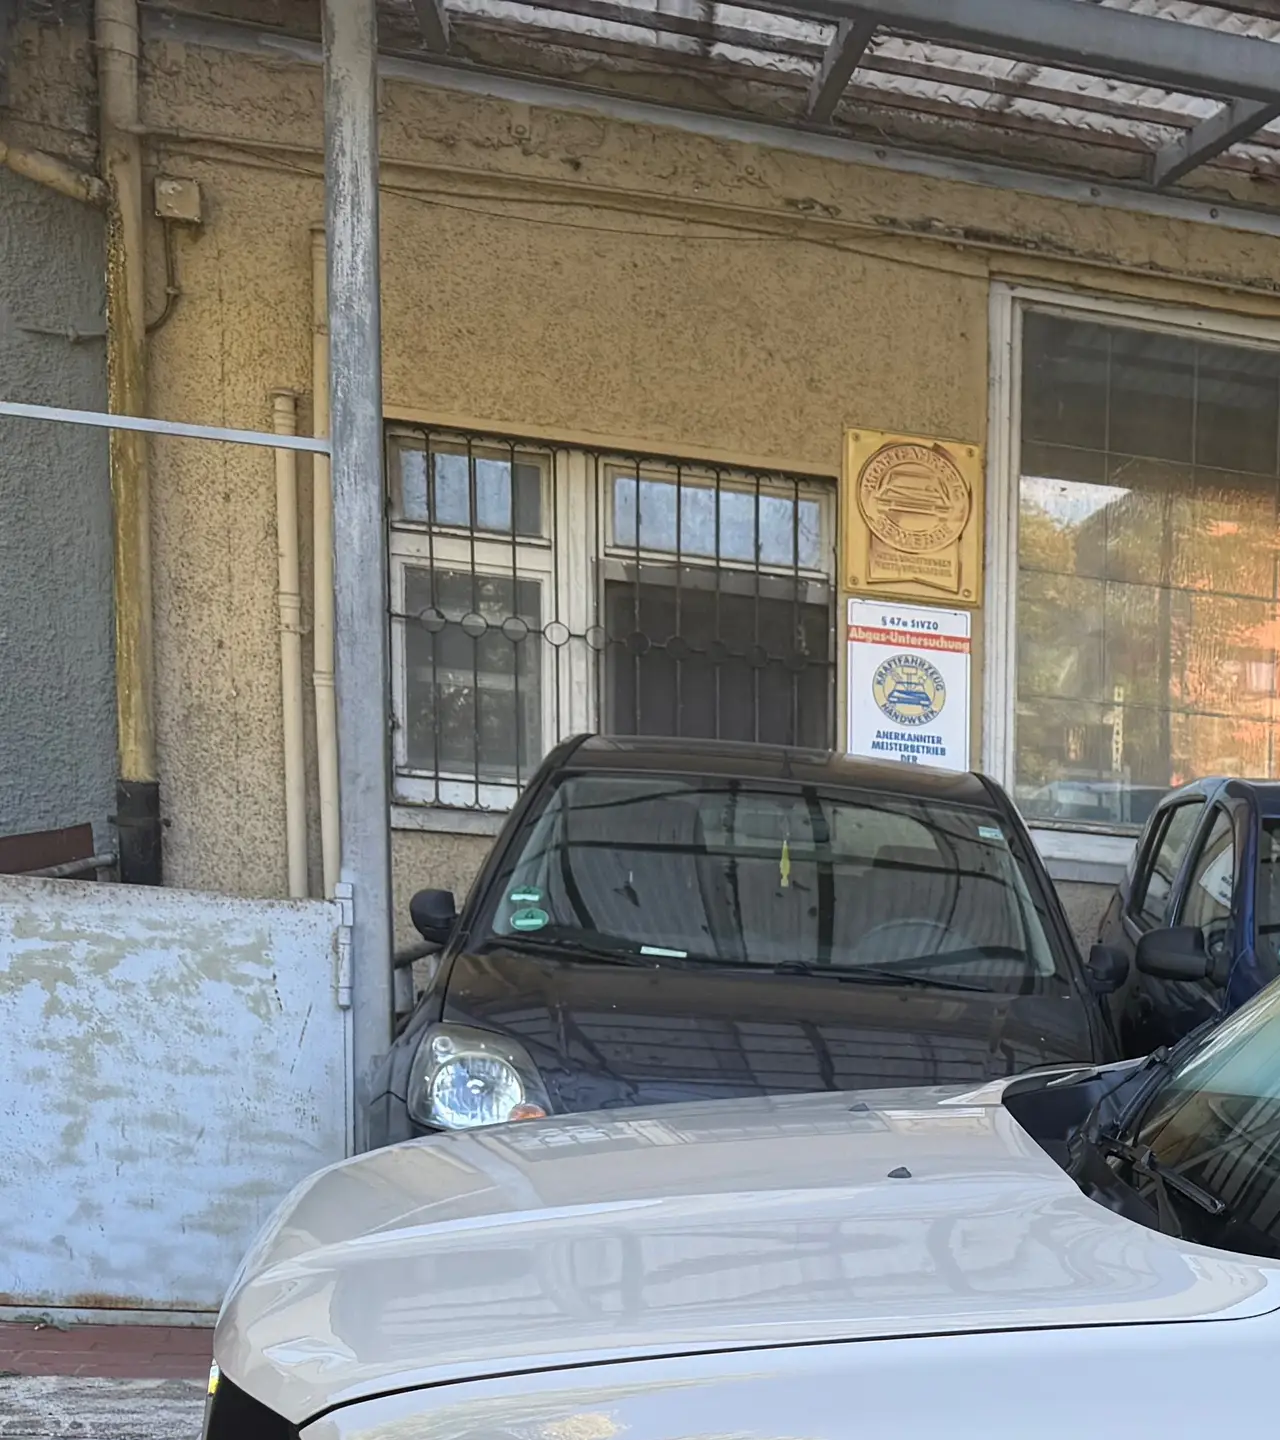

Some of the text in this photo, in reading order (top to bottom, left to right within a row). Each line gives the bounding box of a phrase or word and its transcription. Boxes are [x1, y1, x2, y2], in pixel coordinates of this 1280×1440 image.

[848, 626, 970, 654] Abgas-Untersuchung
[875, 729, 943, 746] ANERKANNTER
[871, 740, 947, 756] MEISTERBETRIEB
